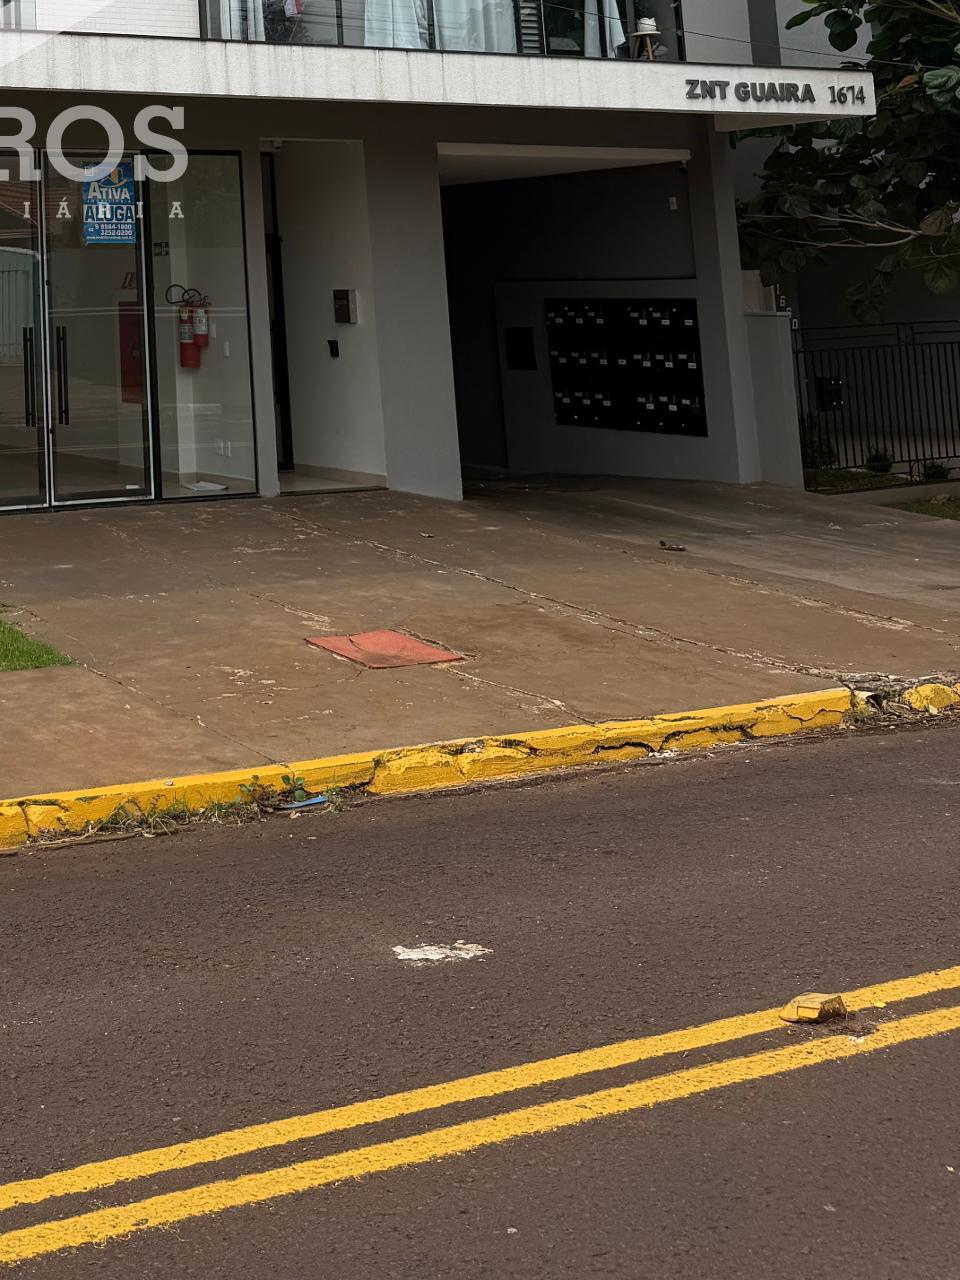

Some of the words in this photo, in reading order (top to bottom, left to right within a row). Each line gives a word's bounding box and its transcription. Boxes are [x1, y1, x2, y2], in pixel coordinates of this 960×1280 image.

[685, 79, 730, 99] ZNT
[734, 82, 816, 103] GUAIRA
[828, 85, 866, 105] 1674
[85, 206, 135, 221] ALUGA
